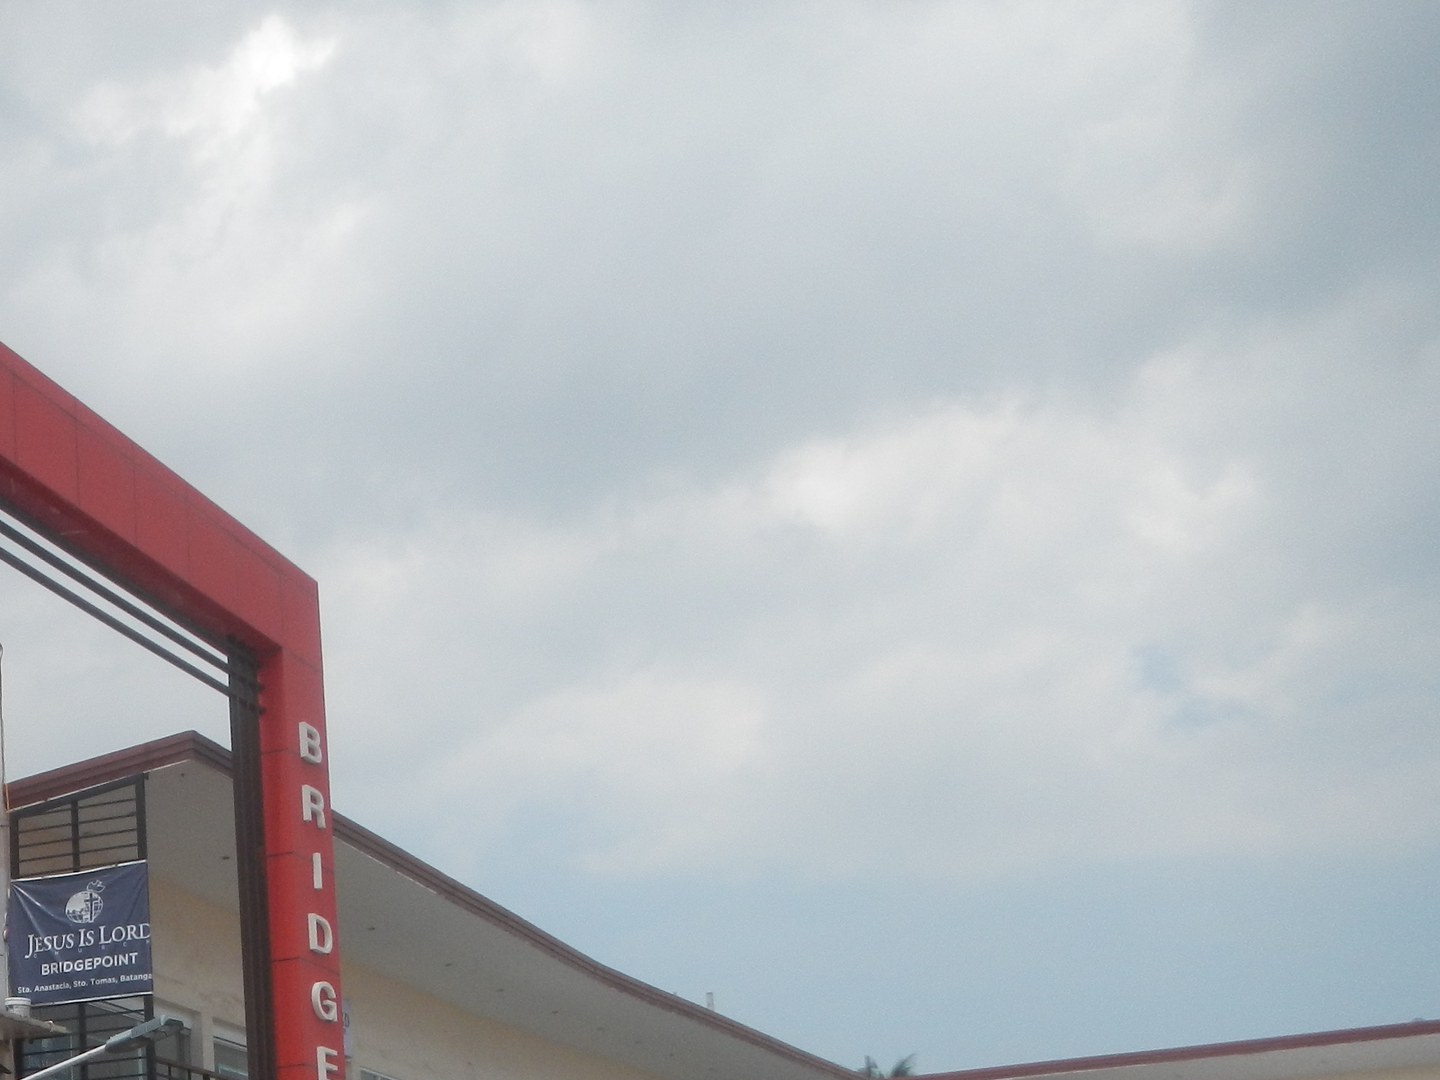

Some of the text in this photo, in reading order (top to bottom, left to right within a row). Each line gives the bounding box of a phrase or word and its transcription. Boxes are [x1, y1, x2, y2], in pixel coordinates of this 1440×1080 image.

[24, 923, 151, 959] JESUS IS LORD
[41, 952, 139, 976] BRIDGEPOINT
[17, 986, 33, 994] Sta.
[73, 979, 89, 989] Sto.
[91, 976, 118, 986] Tomas,
